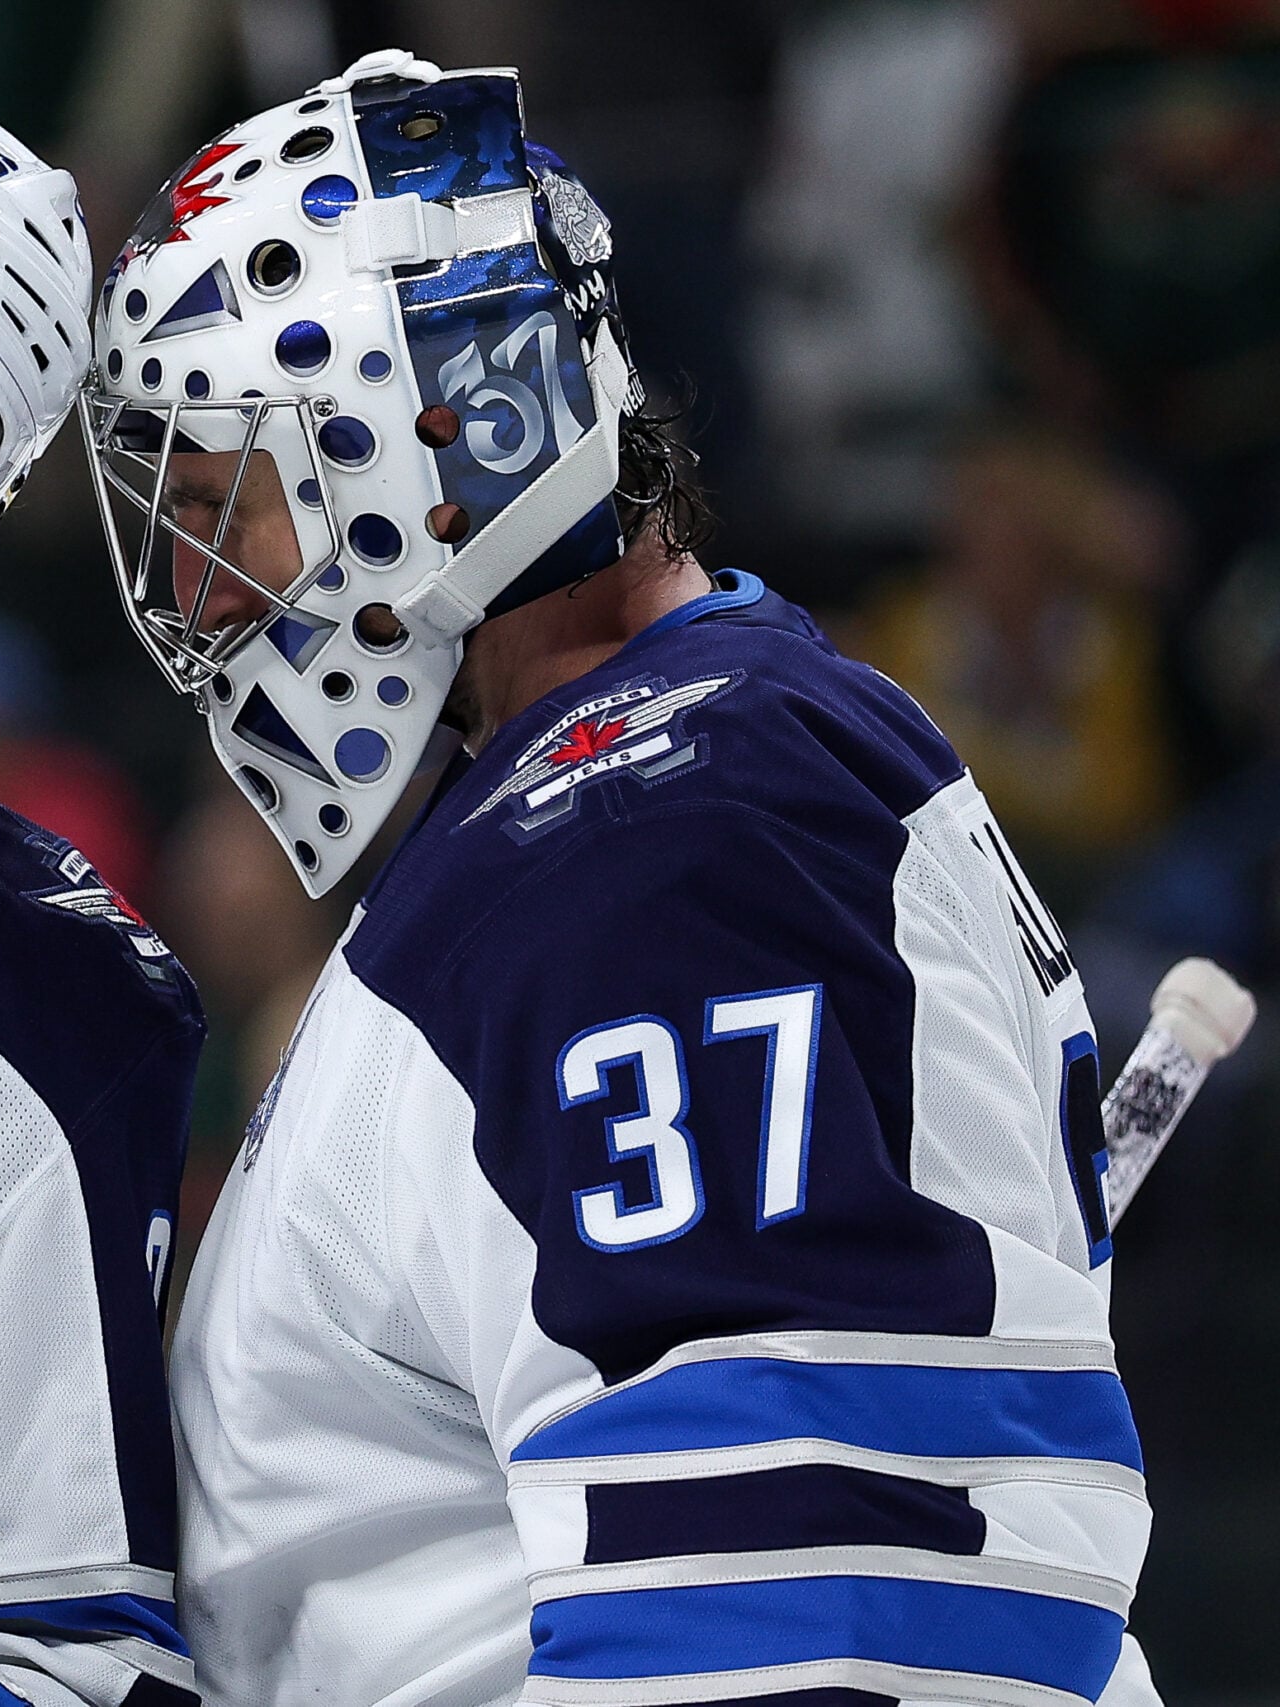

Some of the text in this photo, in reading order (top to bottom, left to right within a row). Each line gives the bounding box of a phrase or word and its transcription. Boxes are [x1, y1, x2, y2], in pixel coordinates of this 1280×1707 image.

[438, 311, 585, 475] 37
[524, 689, 644, 758] WINNIPEG
[566, 751, 632, 786] JETS
[554, 982, 824, 1254] 37
